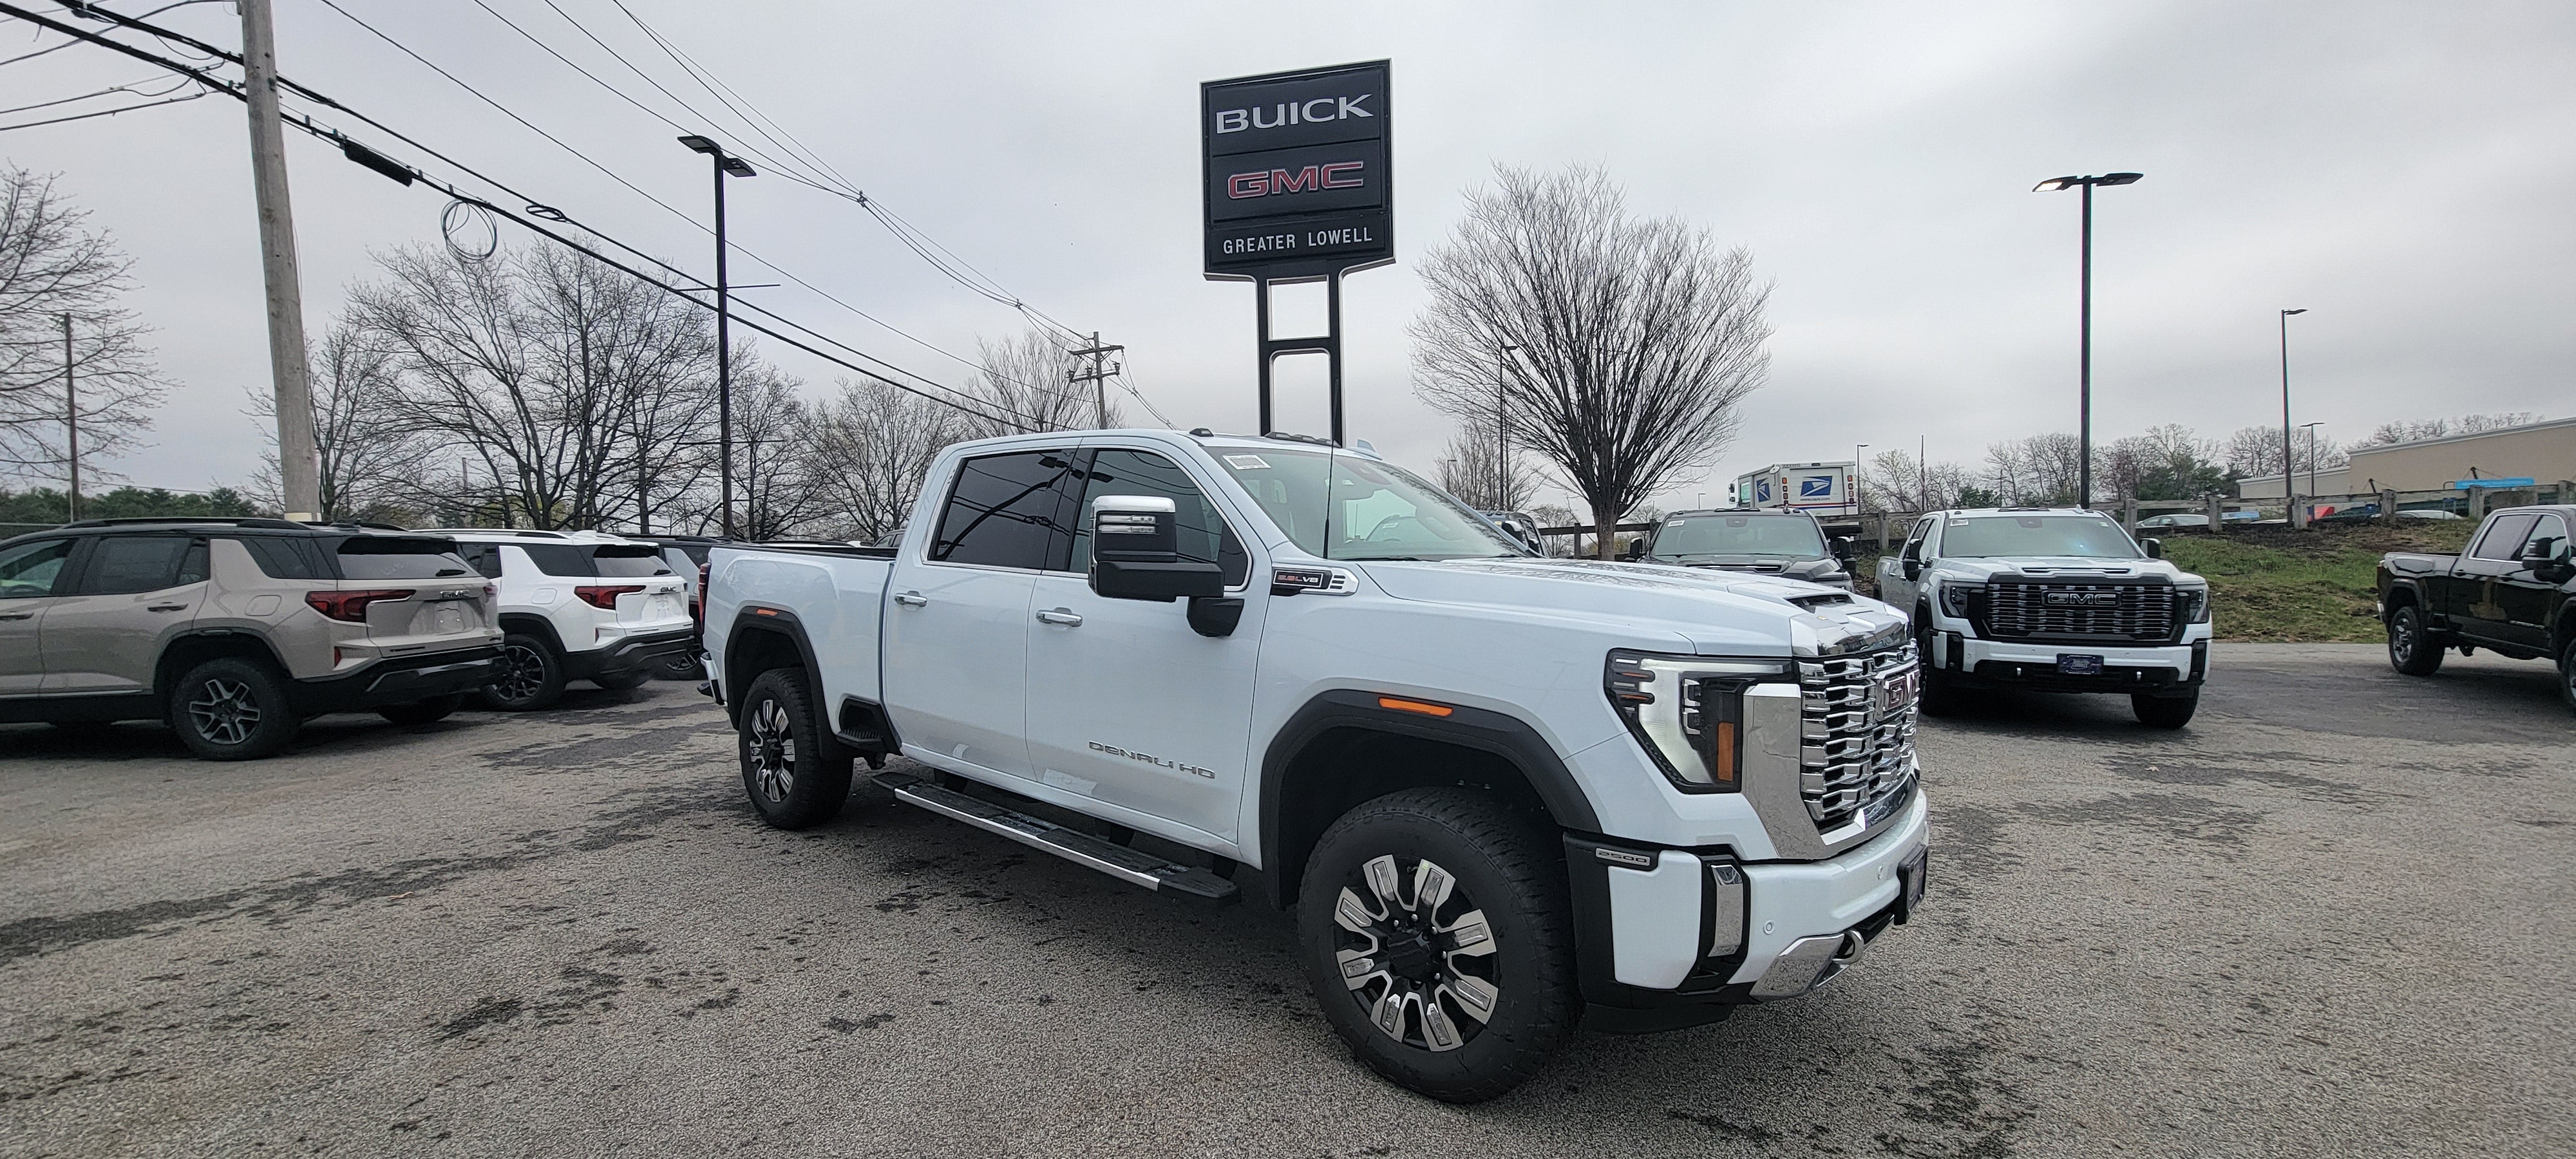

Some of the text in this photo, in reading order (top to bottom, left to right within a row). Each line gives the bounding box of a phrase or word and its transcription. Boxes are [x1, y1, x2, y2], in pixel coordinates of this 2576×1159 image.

[1216, 94, 1374, 134] BUICK
[1227, 161, 1363, 199] GMC
[1224, 227, 1372, 254] GREATER LOWELL
[2048, 593, 2116, 605] GMC
[1089, 740, 1215, 779] DENALI HD
[1598, 851, 1647, 863] 2500
